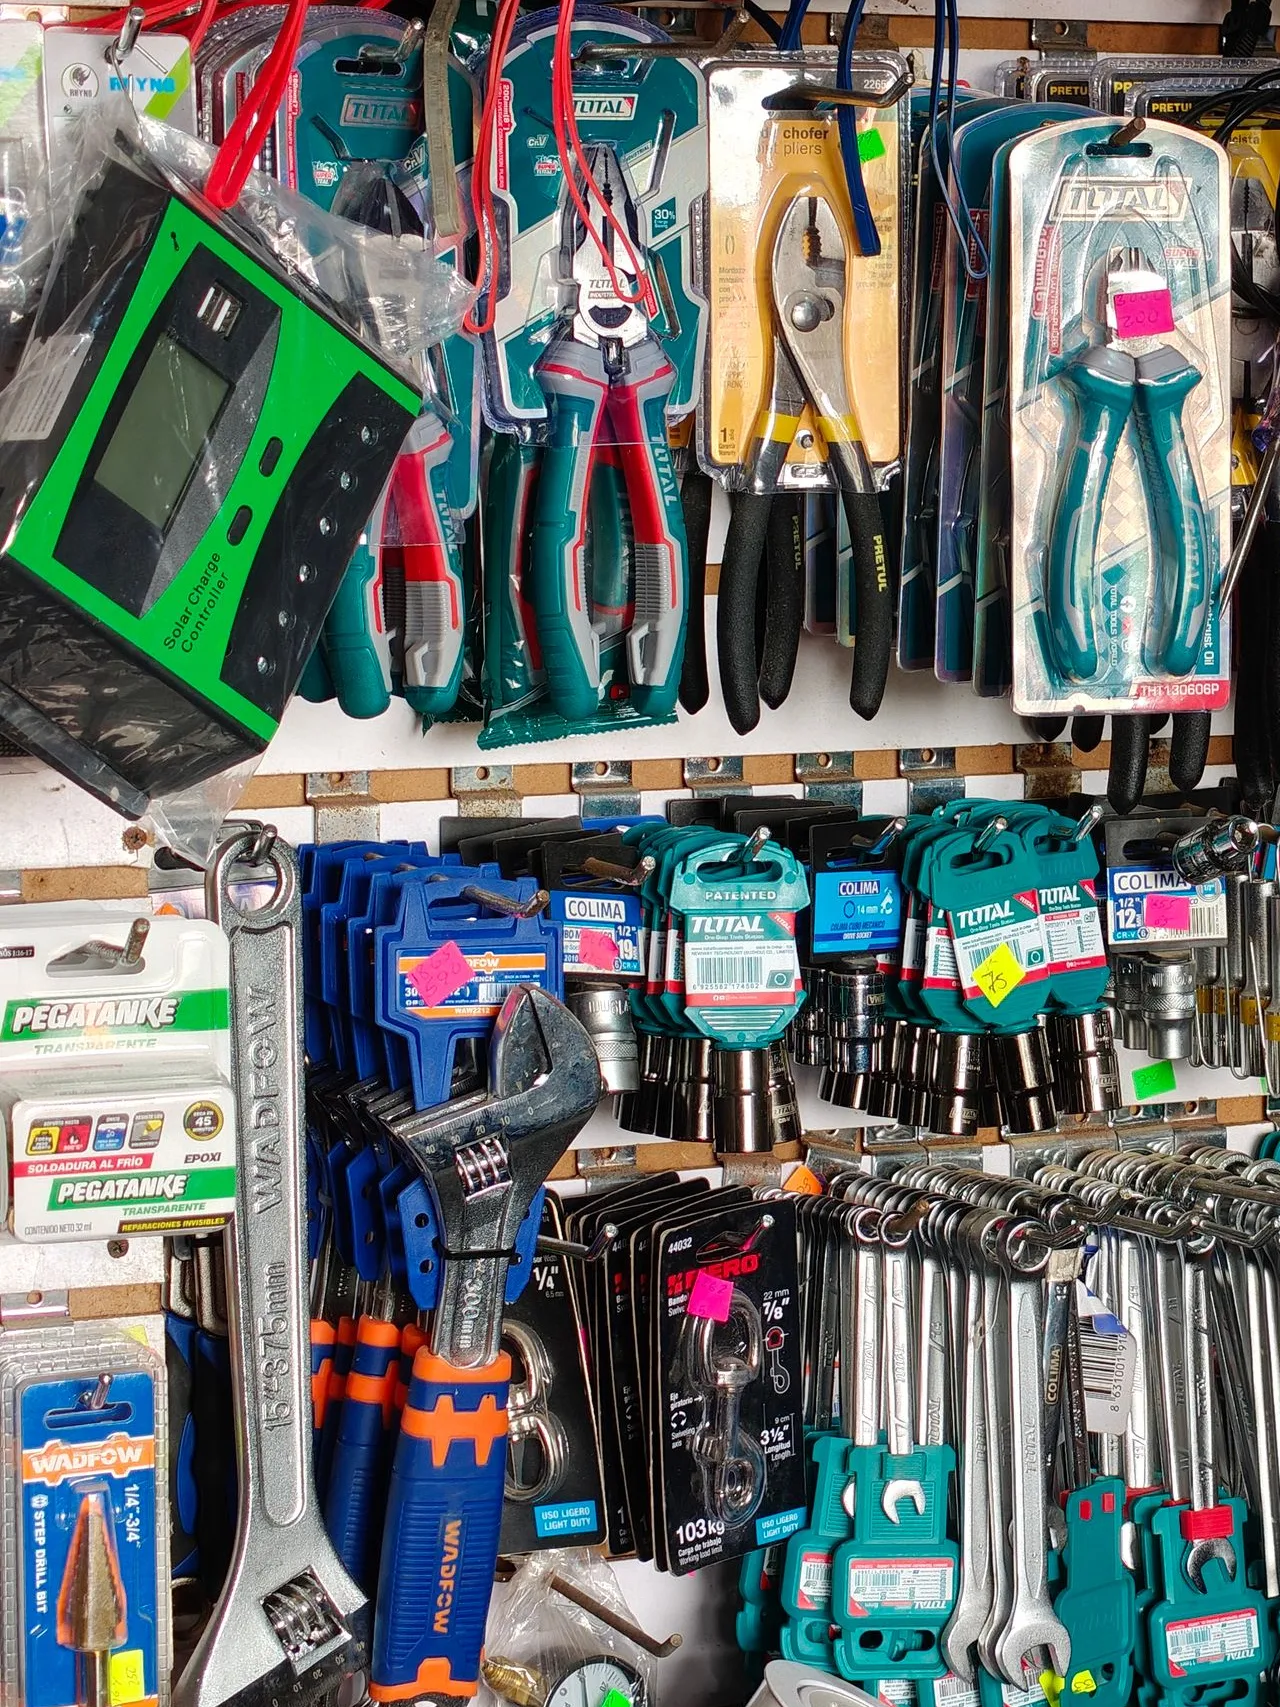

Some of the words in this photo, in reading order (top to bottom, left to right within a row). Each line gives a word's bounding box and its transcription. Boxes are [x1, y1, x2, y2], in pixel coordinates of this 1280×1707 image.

[69, 89, 93, 98] RHYNO
[1050, 86, 1088, 95] PRETU
[783, 127, 829, 139] chofer
[783, 142, 822, 157] pliers
[1070, 186, 1168, 211] TOTAL
[654, 209, 676, 220] 30%
[650, 433, 678, 507] TOTAL
[434, 488, 459, 555] TOTAL
[873, 534, 888, 592] PRETUL
[164, 606, 193, 650] Solar
[188, 553, 220, 605] Charge
[181, 571, 229, 653] Controller
[1110, 612, 1118, 635] TOOLS
[1140, 684, 1219, 697] THT130606P
[839, 881, 879, 895] COLIMA
[1118, 873, 1188, 891] COLIMA
[705, 891, 777, 901] PATENTED
[1039, 885, 1081, 905] TOTAL
[1119, 897, 1140, 908] 1/2"
[568, 900, 622, 919] COLIMA
[857, 905, 865, 914] 14
[866, 906, 878, 914] mm
[957, 900, 1014, 928] TOTAL
[691, 915, 764, 933] TOTAL
[774, 914, 792, 931] TOTAL
[1117, 908, 1137, 929] 12
[617, 925, 636, 937] 1/2"
[1116, 931, 1136, 939] CR-V
[619, 939, 633, 960] 19
[623, 961, 638, 969] CR-V
[12, 998, 178, 1033] PEGATANKE
[455, 1007, 490, 1015] WAW2212
[247, 986, 282, 1215] WADFOW
[195, 1117, 212, 1126] 45
[425, 1143, 436, 1154] 40
[450, 1133, 461, 1145] 30
[475, 1124, 486, 1136] 20
[500, 1115, 511, 1126] 10
[28, 1161, 97, 1174] SOLDADURA
[99, 1160, 114, 1169] AL
[116, 1155, 144, 1168] FRÍO
[184, 1152, 221, 1163] EPOXI
[58, 1174, 187, 1204] PEGATANKE
[122, 1202, 207, 1216] TRANSPARENTE
[25, 1225, 59, 1235] CONTENIDO
[59, 1223, 75, 1233] NETO
[122, 1220, 181, 1232] REPARACIONES
[183, 1217, 226, 1228] INVISIBLES
[668, 1238, 692, 1254] 44032
[763, 1291, 773, 1300] 22
[774, 1288, 789, 1297] mm
[763, 1298, 790, 1322] 7/8"
[1047, 1348, 1060, 1400] COLIMA
[1112, 1355, 1126, 1398] 631001
[670, 1392, 679, 1401] Eje
[670, 1397, 694, 1411] giratorio
[774, 1416, 780, 1424] 9
[780, 1415, 790, 1423] cm
[764, 1440, 791, 1454] Longitud
[31, 1446, 143, 1474] WADFOW
[771, 1450, 791, 1462] Length
[541, 1509, 559, 1520] USO
[560, 1507, 591, 1518] LIGERO
[761, 1518, 775, 1529] USO
[775, 1513, 798, 1525] LIGERO
[34, 1511, 46, 1546] STEP
[544, 1518, 568, 1530] LIGHT
[570, 1516, 591, 1528] DUTY
[763, 1528, 781, 1539] LIGHT
[782, 1522, 799, 1535] DUTY
[678, 1546, 694, 1557] Carga
[695, 1544, 702, 1552] de
[702, 1538, 722, 1551] trabajo
[679, 1553, 700, 1566] Working
[712, 1545, 723, 1555] limit
[35, 1549, 48, 1590] DRILL
[432, 1518, 462, 1635] WADFOW
[36, 1592, 48, 1614] BIT
